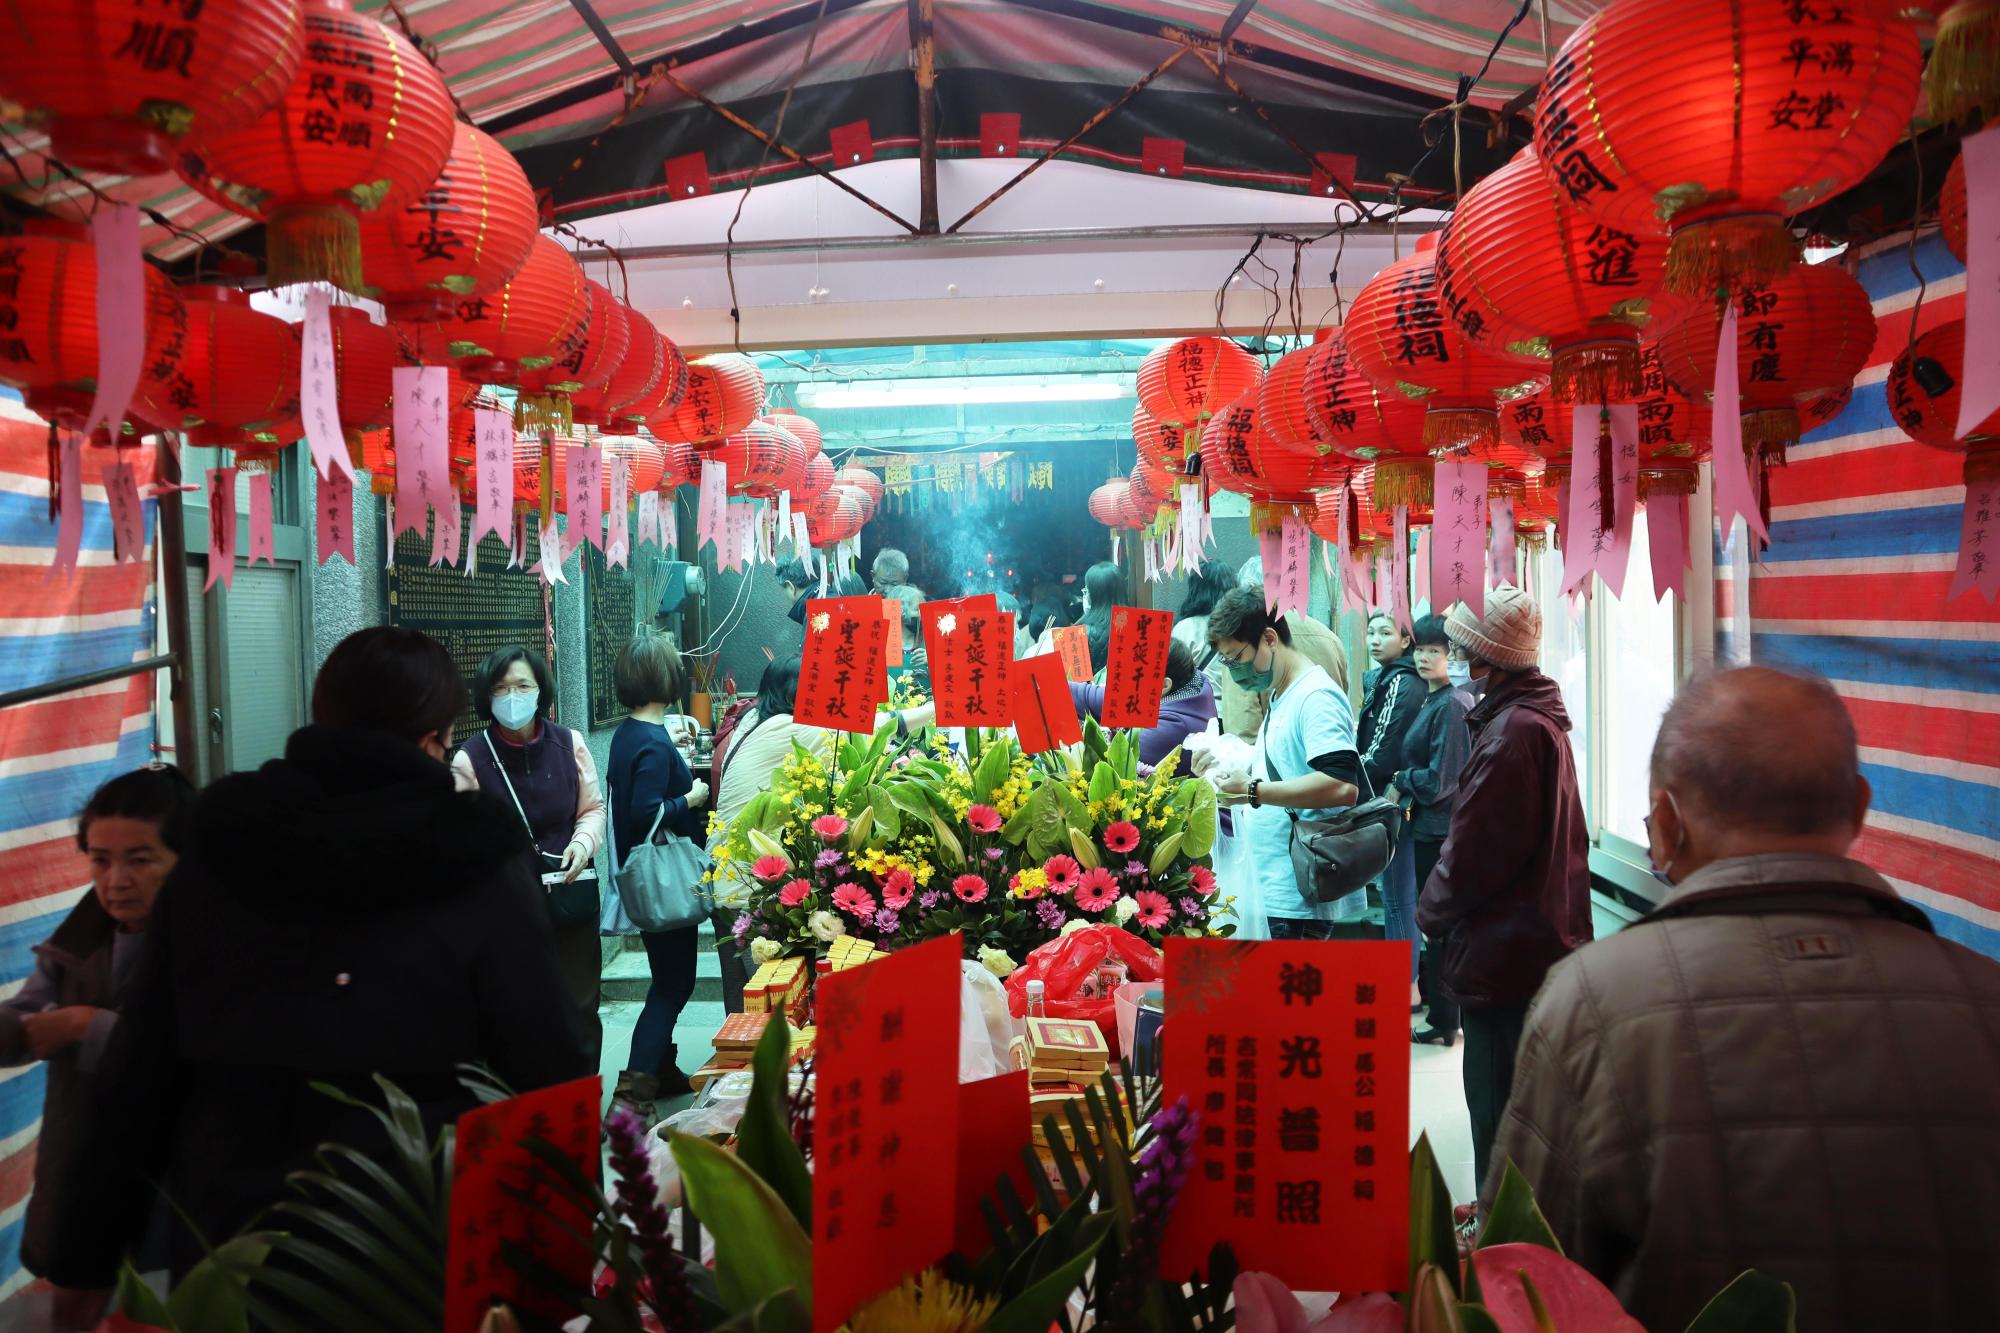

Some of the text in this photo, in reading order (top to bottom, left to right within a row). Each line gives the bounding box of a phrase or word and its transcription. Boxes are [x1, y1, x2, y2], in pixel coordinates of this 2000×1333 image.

[1391, 267, 1449, 367] 福德祠
[1176, 342, 1207, 409] 福德正神
[1225, 407, 1258, 479] 福德祠
[1276, 962, 1323, 1225] 神光普照
